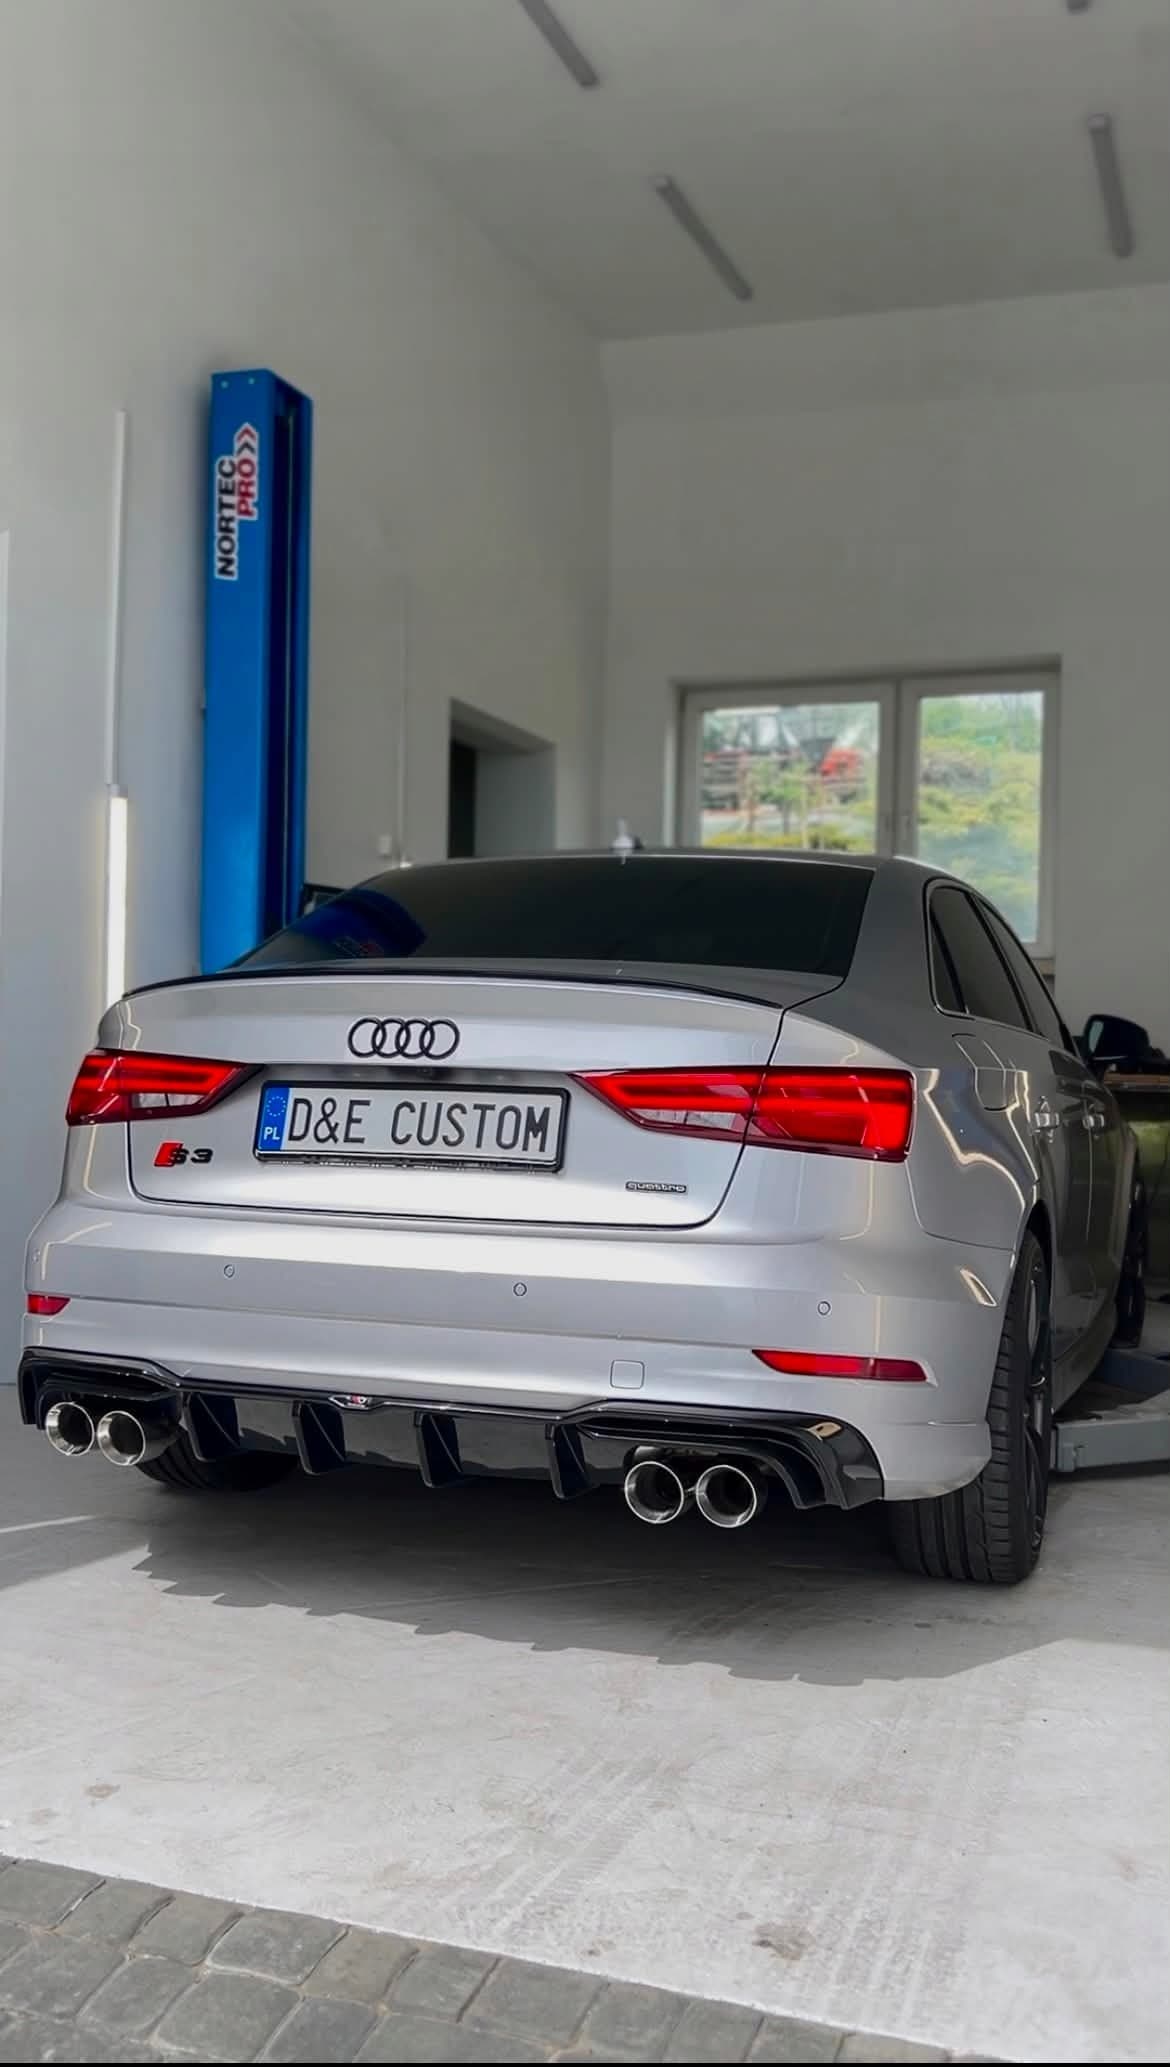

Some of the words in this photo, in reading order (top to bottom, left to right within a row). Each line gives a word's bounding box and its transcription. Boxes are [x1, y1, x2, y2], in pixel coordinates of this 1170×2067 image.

[236, 457, 256, 518] PRO
[217, 458, 236, 577] NORTEC
[263, 1126, 280, 1141] PL
[288, 1096, 371, 1145] D&E
[391, 1100, 551, 1153] CUSTOM
